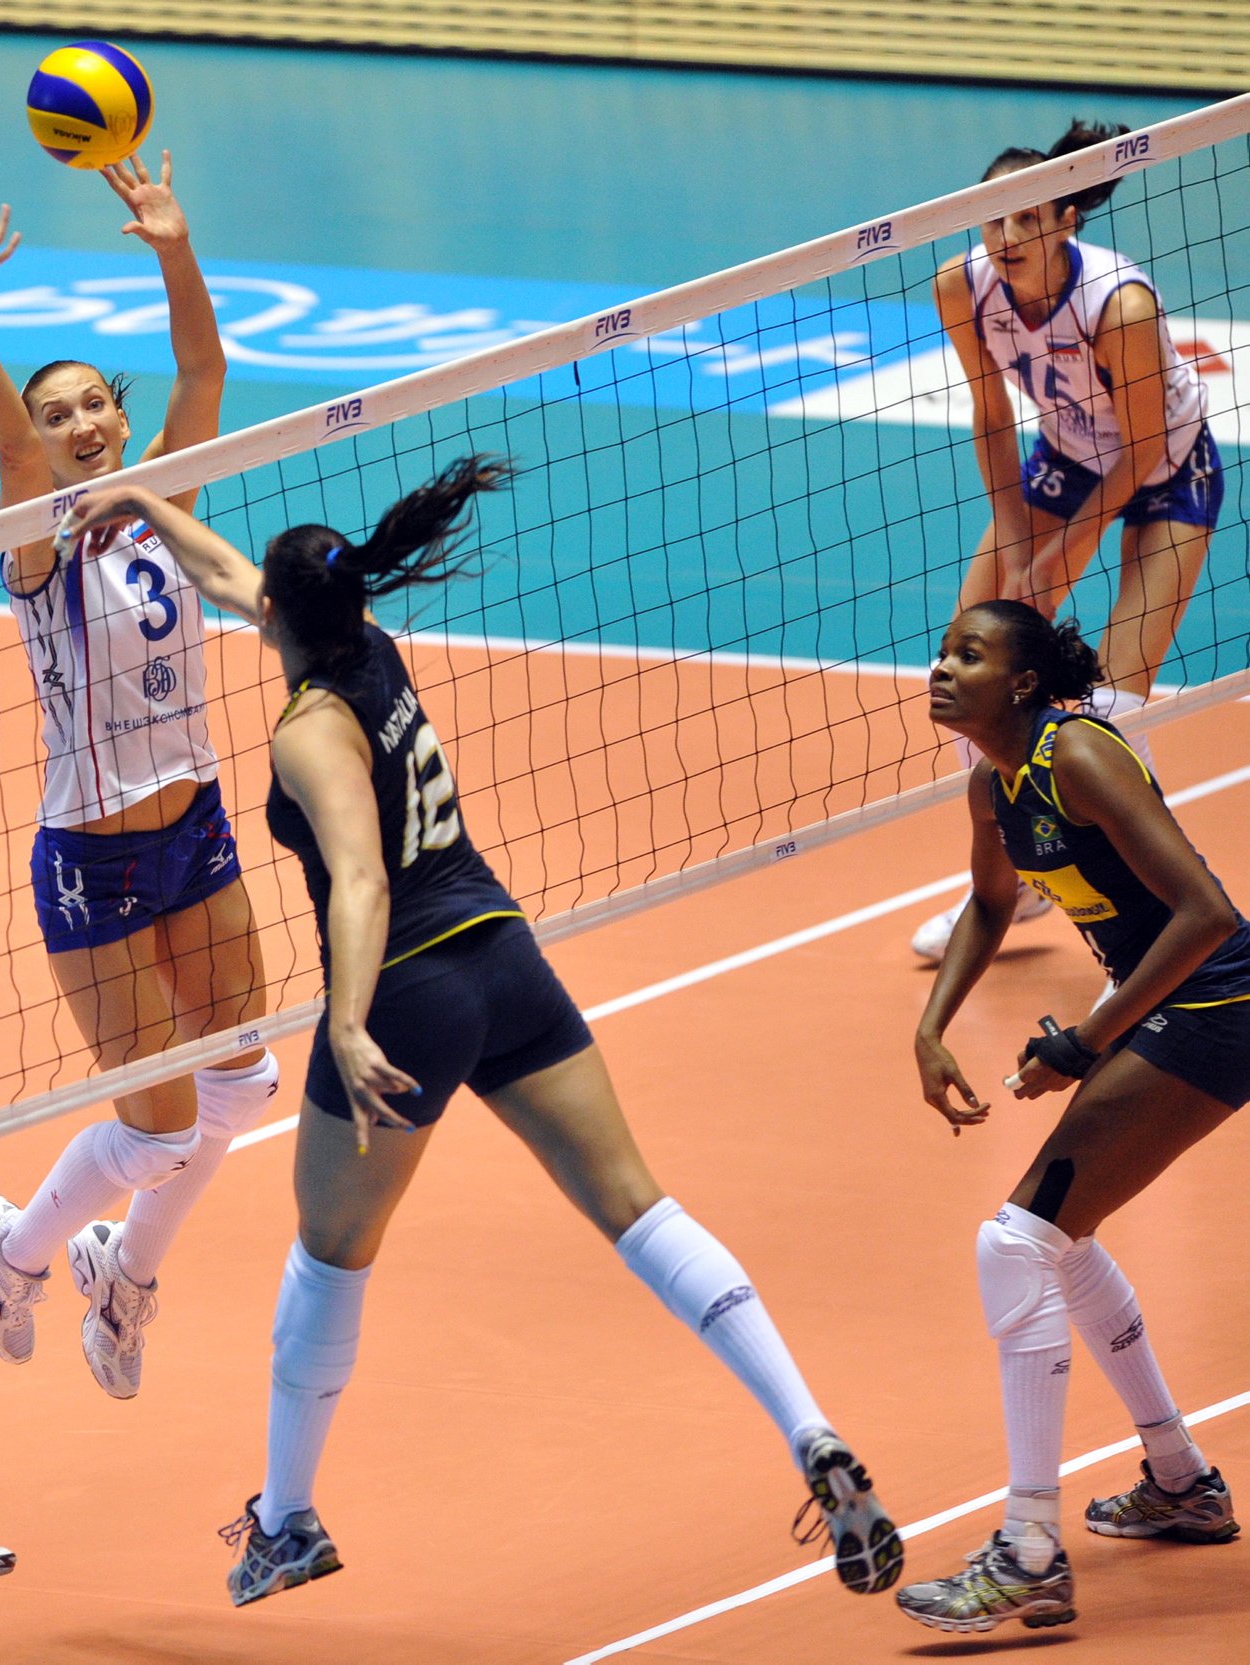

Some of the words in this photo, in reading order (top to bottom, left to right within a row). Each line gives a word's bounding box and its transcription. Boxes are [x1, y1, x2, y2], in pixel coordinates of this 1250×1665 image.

[1114, 135, 1150, 163] FIVB
[857, 221, 892, 249] FIVB
[594, 309, 632, 337] FIVB
[326, 398, 363, 427] FIVB
[52, 489, 89, 518] FIV
[125, 558, 178, 642] 3
[401, 722, 461, 869] 12
[1035, 840, 1067, 856] BRA
